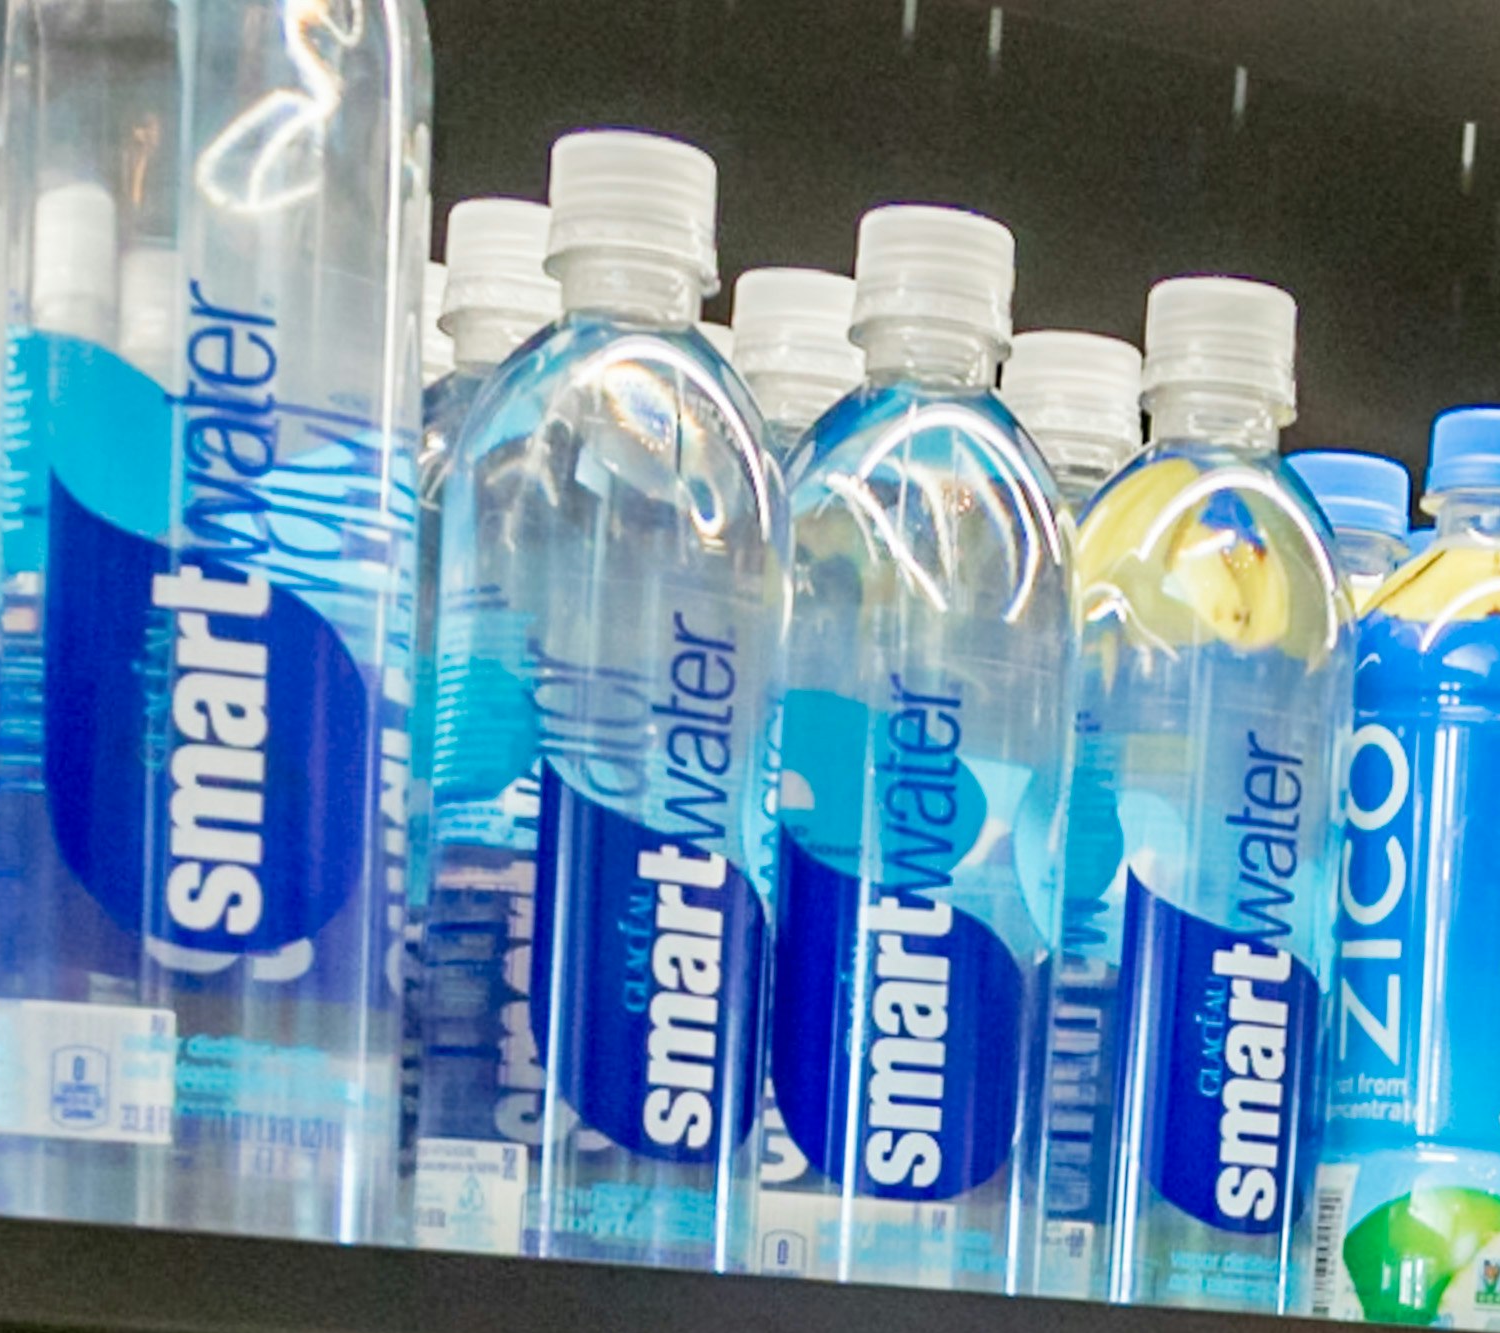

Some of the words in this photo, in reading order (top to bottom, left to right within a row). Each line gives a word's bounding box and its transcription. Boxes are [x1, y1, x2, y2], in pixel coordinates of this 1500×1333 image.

[152, 280, 277, 936] smartwater
[637, 612, 738, 1150] smartwater
[866, 674, 963, 1190] smartwater
[1212, 730, 1306, 1223] smartwater
[1339, 723, 1410, 1067] ZICO
